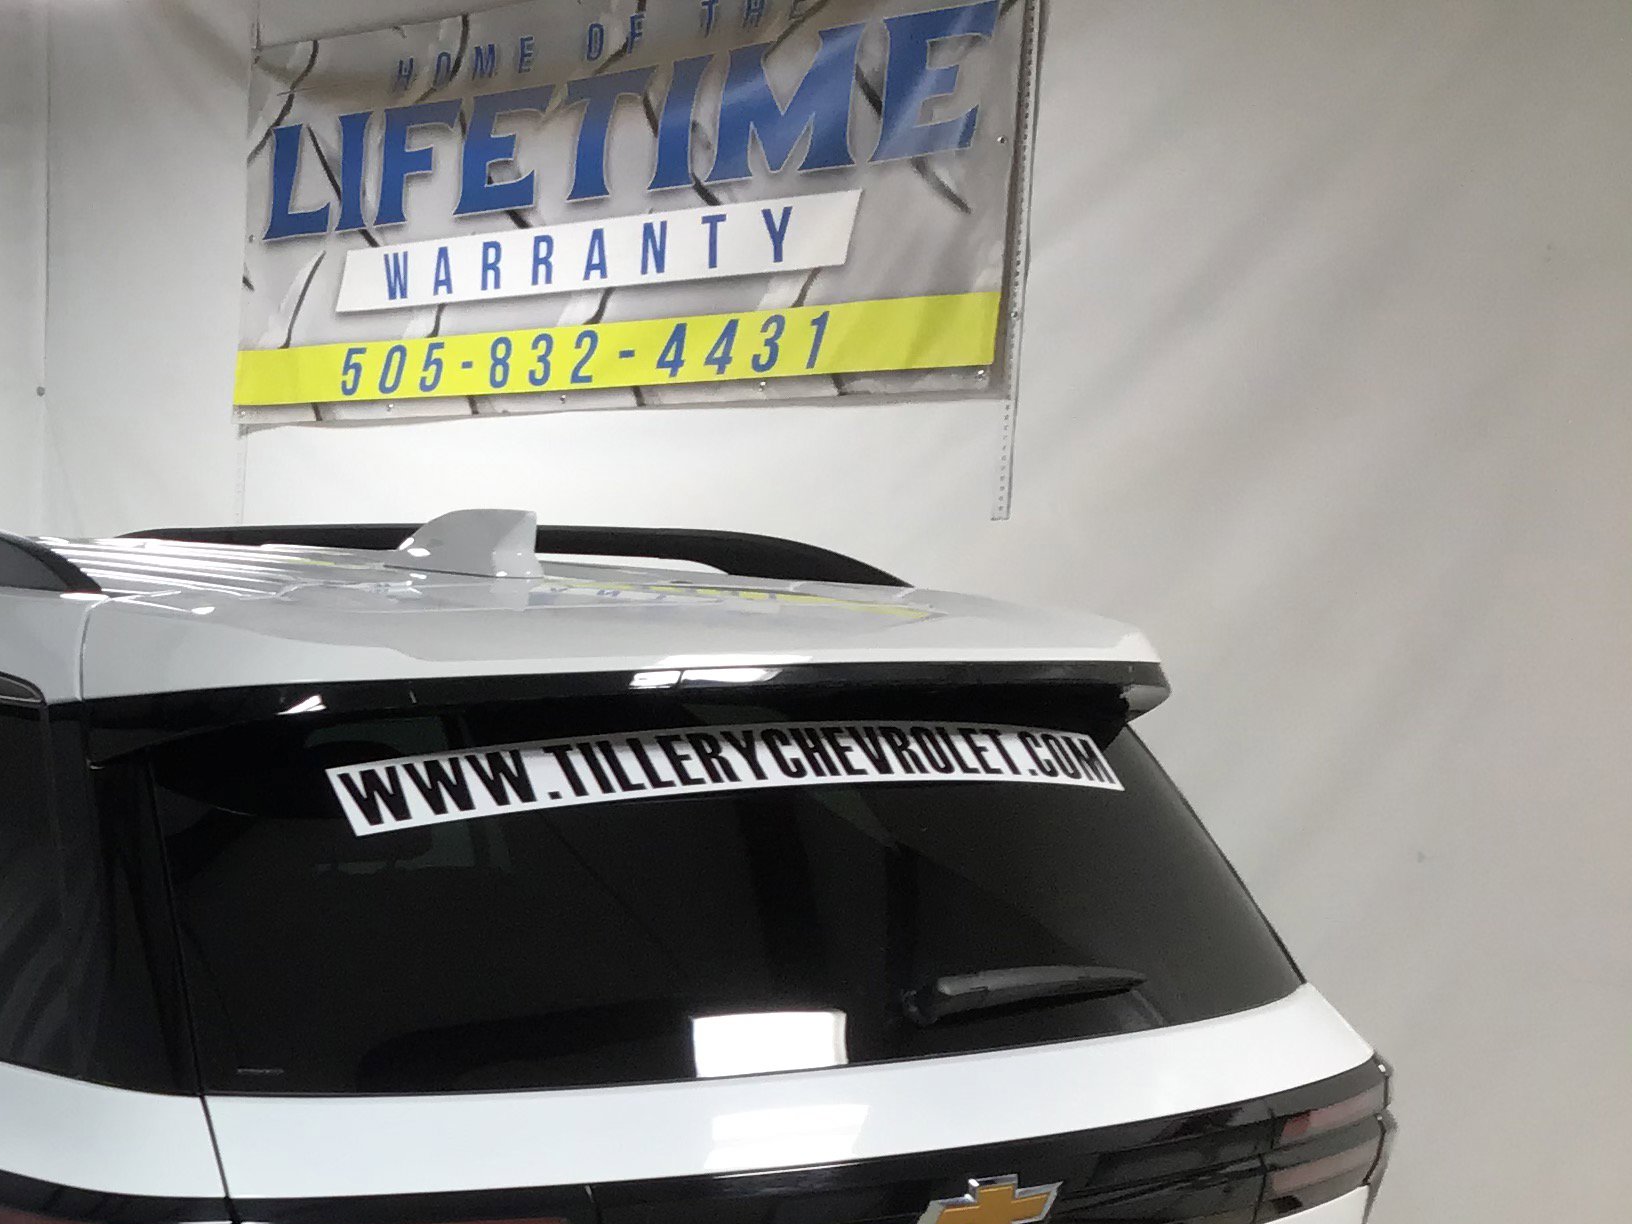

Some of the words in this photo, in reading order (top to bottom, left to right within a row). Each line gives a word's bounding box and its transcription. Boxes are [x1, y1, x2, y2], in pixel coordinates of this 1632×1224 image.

[393, 36, 535, 92] HOME
[585, 13, 646, 62] OF
[263, 3, 998, 242] LIFETIME
[383, 206, 795, 302] WARRANTY
[341, 310, 831, 396] 505-832-4431
[339, 723, 1108, 826] WWW.TILLERYCHEVROLET.COM
